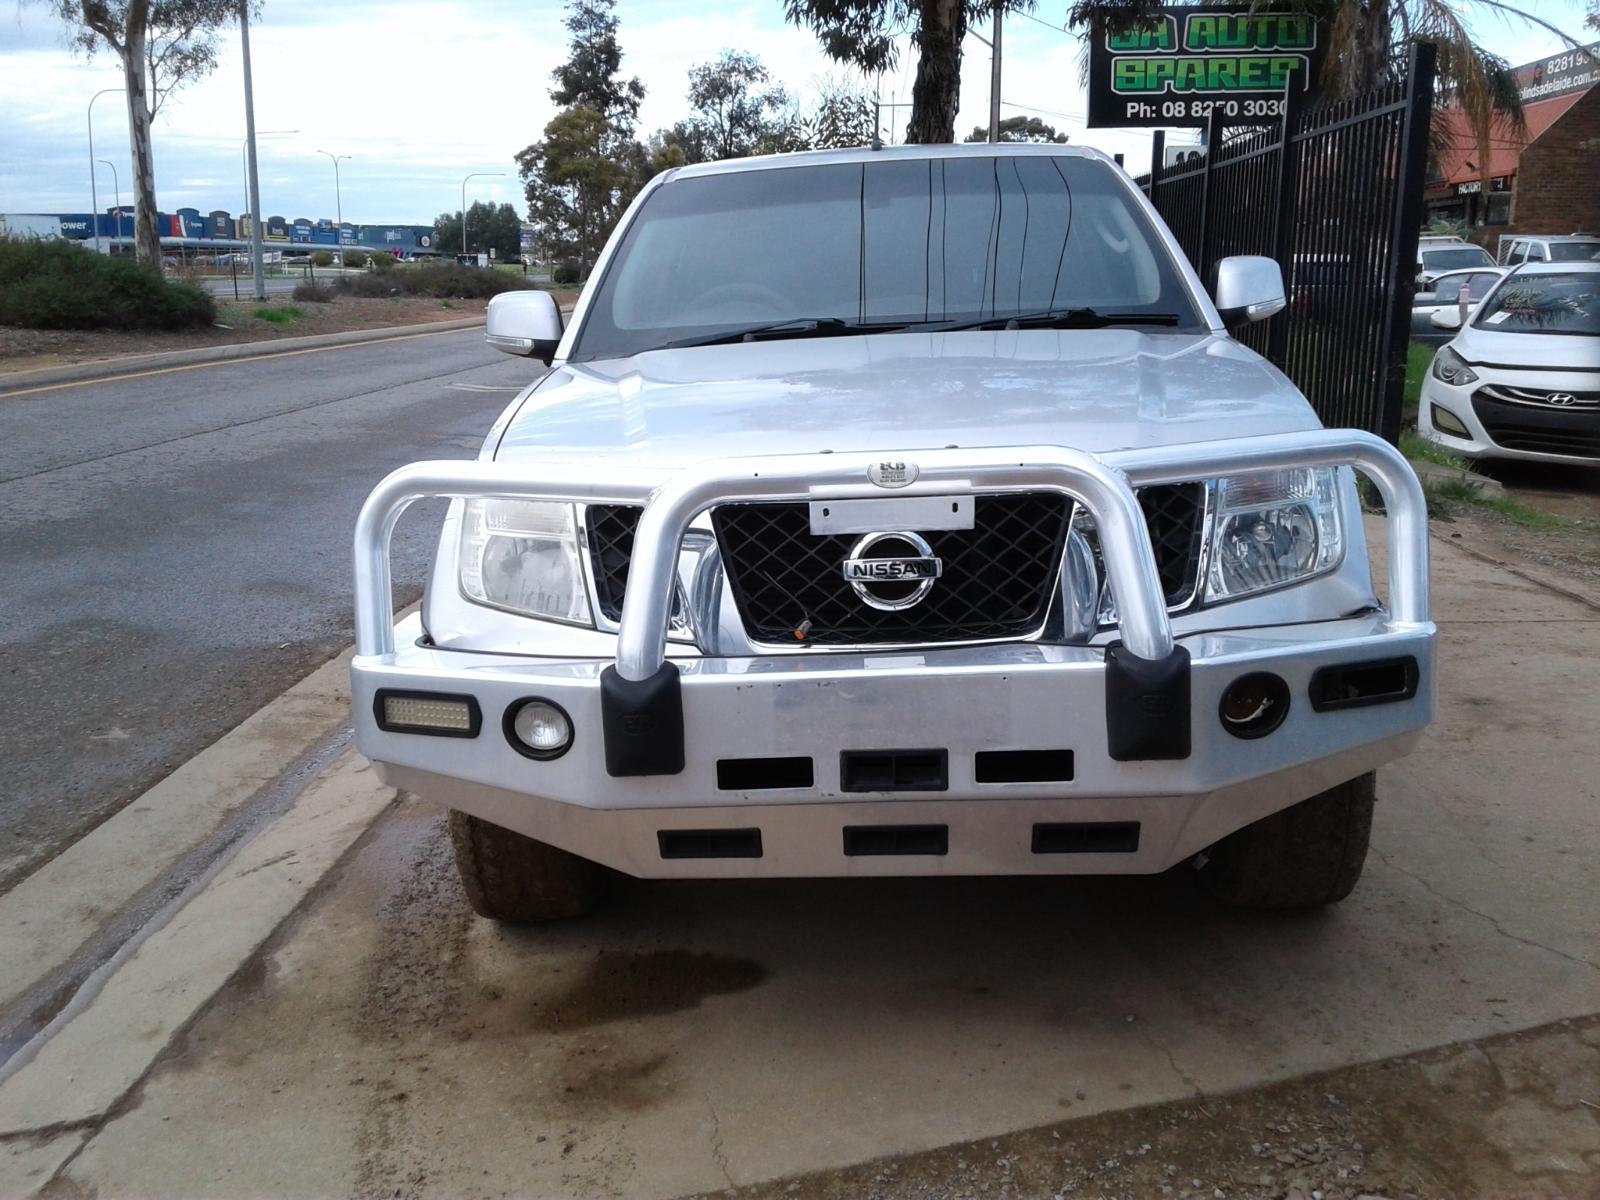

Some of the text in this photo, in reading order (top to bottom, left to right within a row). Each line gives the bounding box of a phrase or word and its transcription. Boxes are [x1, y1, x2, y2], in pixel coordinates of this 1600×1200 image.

[1188, 16, 1309, 48] AUTO
[1116, 57, 1299, 89] SPARES
[1127, 102, 1156, 118] Ph:
[1162, 102, 1186, 117] 08
[61, 221, 87, 230] ower
[853, 563, 931, 577] NISSAN
